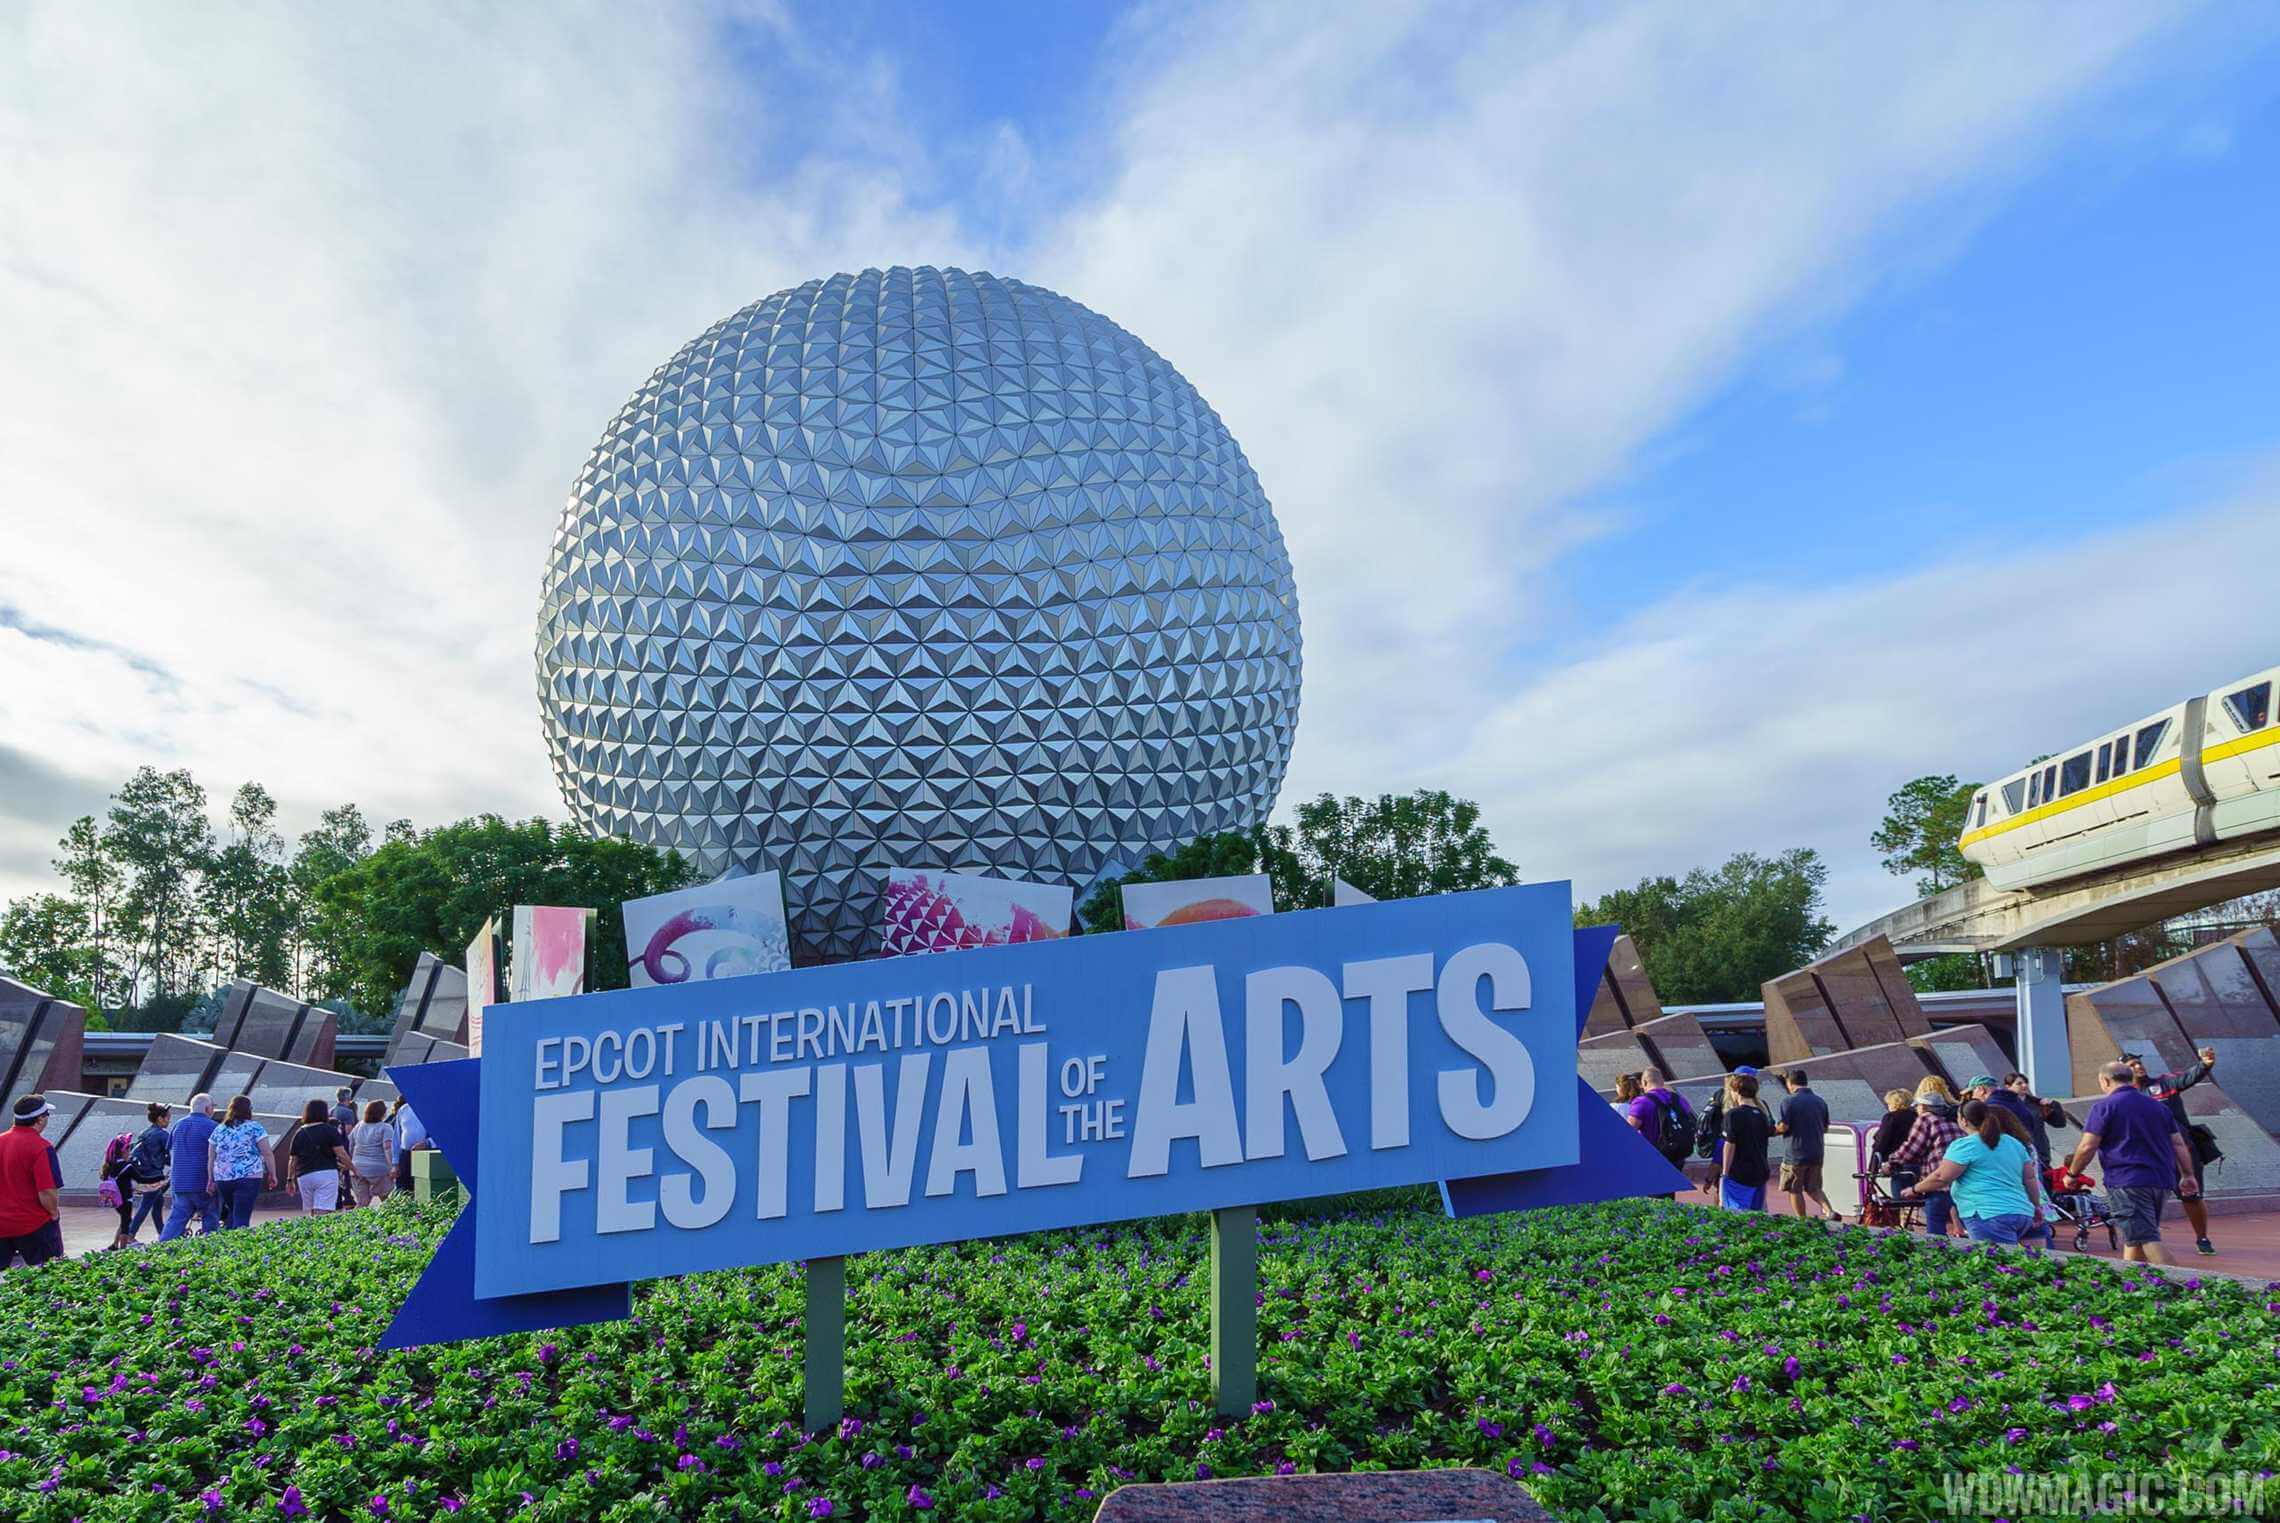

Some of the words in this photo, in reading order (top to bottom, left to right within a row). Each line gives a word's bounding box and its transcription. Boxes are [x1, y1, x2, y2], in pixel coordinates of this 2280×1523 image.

[535, 1022, 684, 1091] EPCOT
[697, 984, 1047, 1072] INTERNATIONAL
[1061, 1055, 1106, 1098] OF
[1127, 943, 1535, 1178] ARTS
[530, 1042, 1084, 1243] FESTIVAL
[1059, 1100, 1125, 1144] THE
